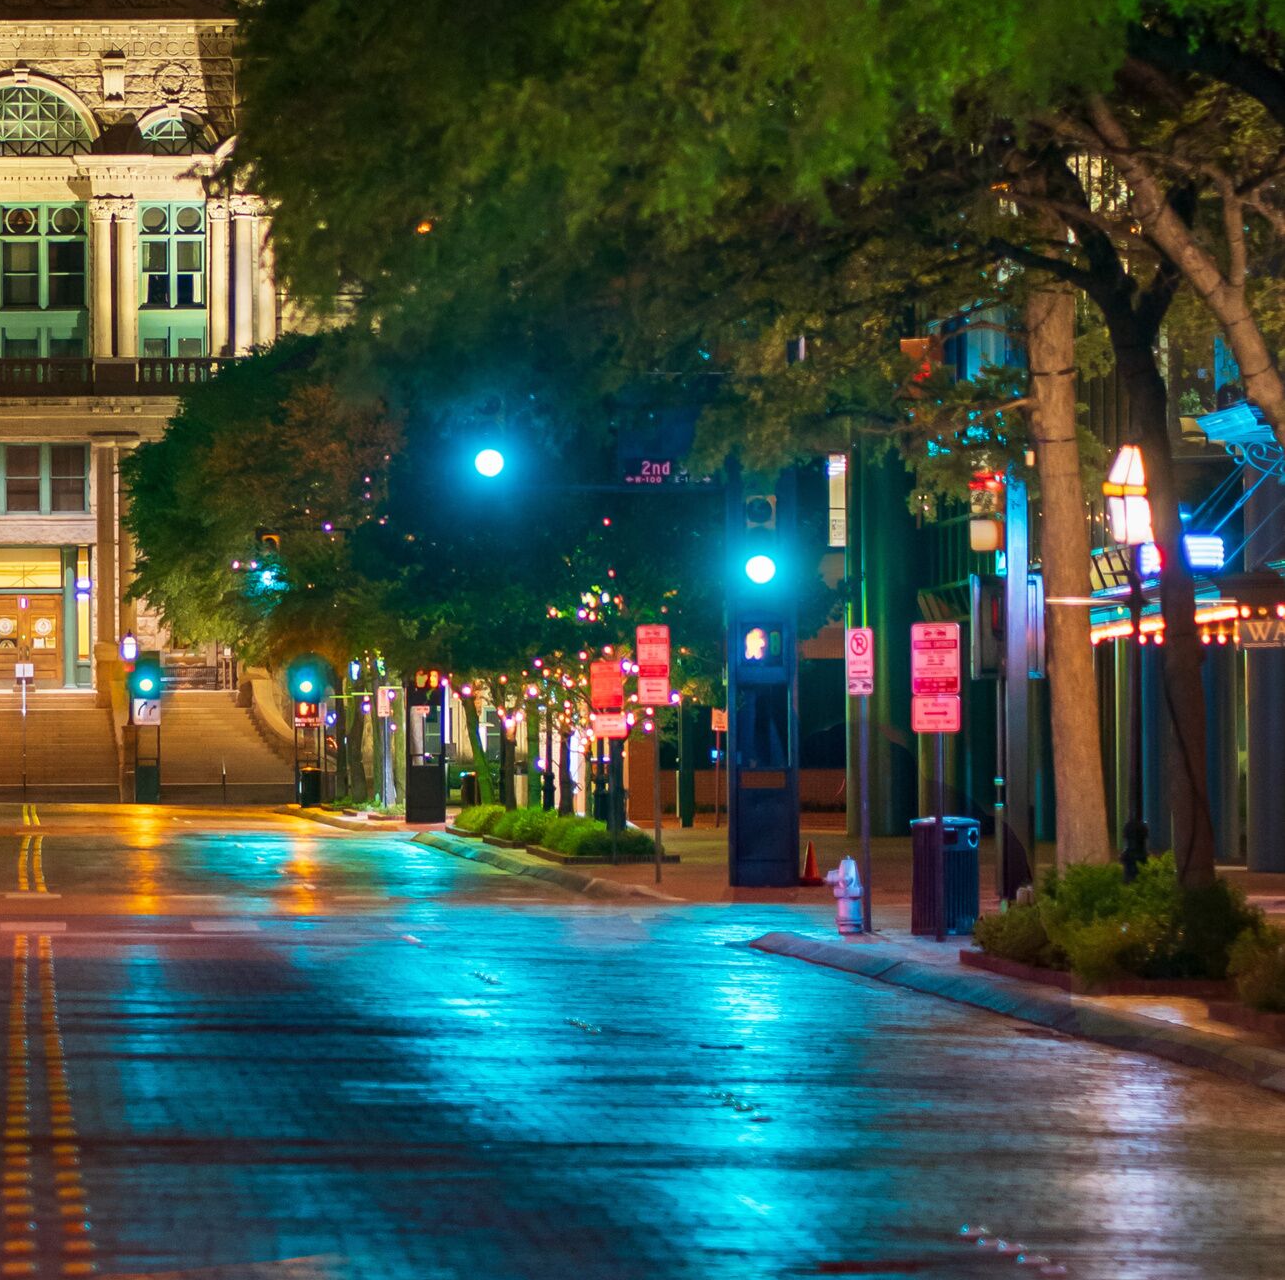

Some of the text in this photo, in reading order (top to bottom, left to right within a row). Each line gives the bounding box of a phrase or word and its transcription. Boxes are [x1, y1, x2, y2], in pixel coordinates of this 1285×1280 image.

[44, 42, 57, 57] A
[77, 41, 91, 57] D
[641, 460, 671, 476] 2nd
[634, 476, 662, 484] W-100
